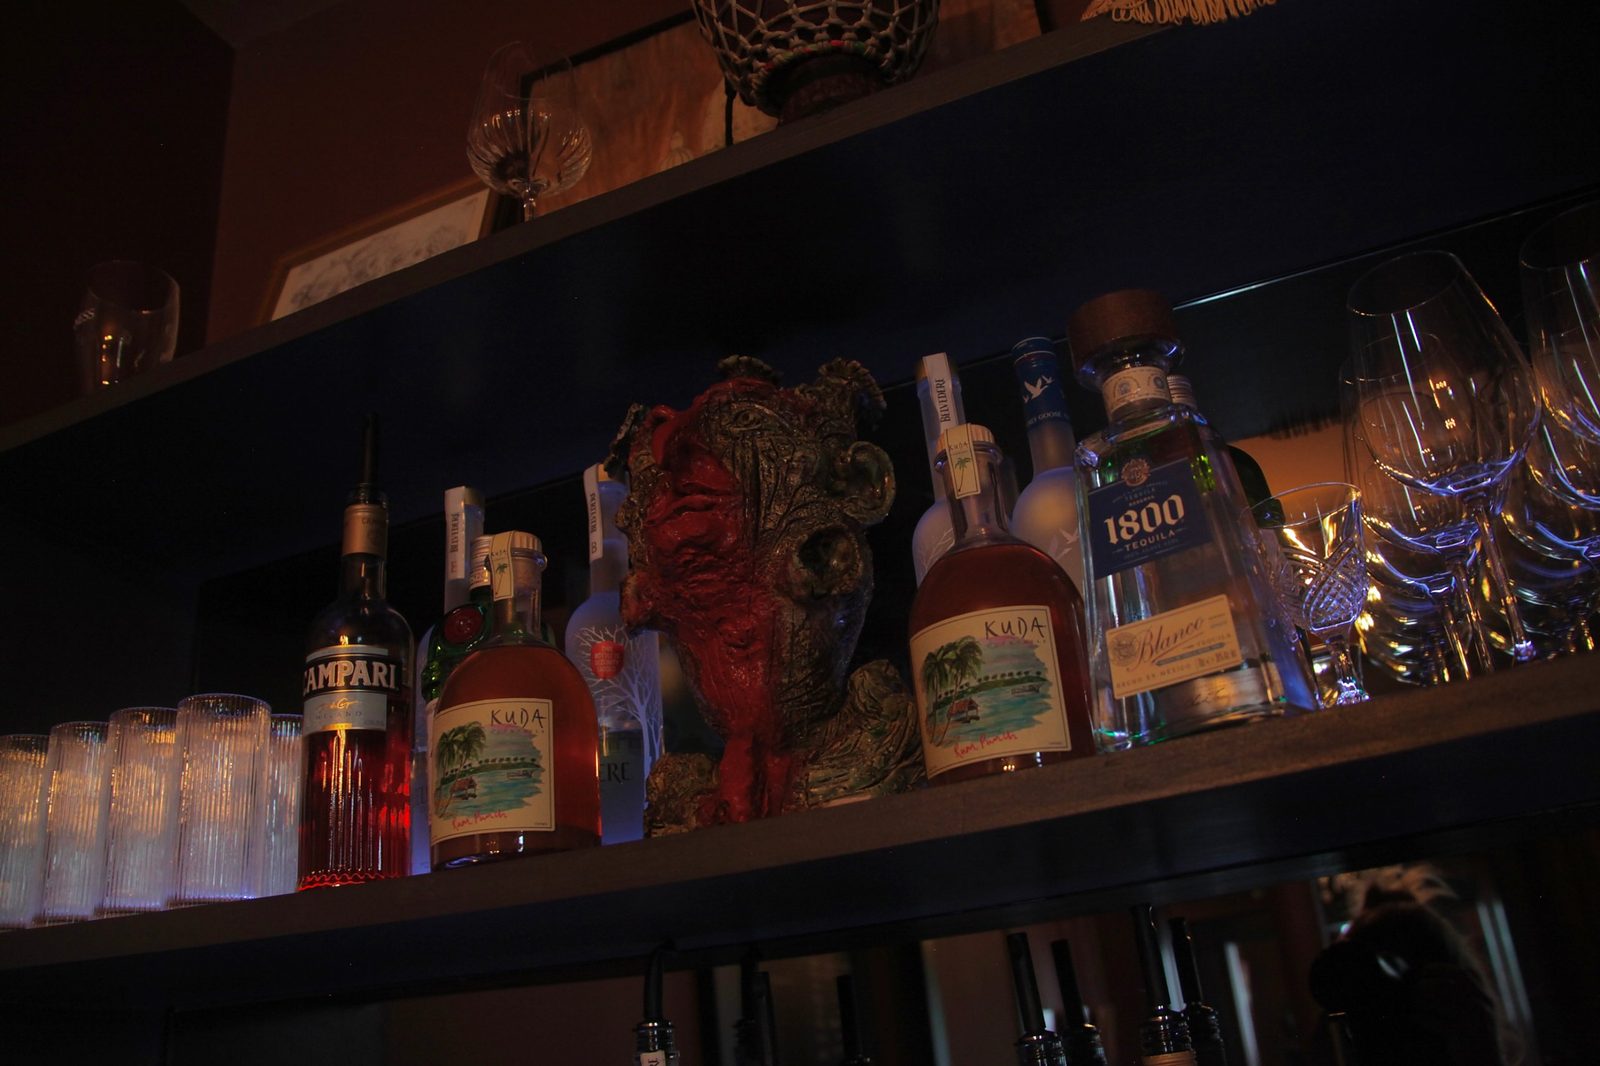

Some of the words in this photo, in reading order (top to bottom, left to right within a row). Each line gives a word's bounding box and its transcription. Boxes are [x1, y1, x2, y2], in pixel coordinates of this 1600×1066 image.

[935, 378, 951, 422] BELVEDERE
[1103, 493, 1185, 545] 1800
[1124, 529, 1176, 552] TEQUILA
[984, 616, 1046, 640] KUDA
[1126, 617, 1205, 672] Blanco
[490, 707, 547, 728] KUDA
[953, 742, 979, 759] Rum
